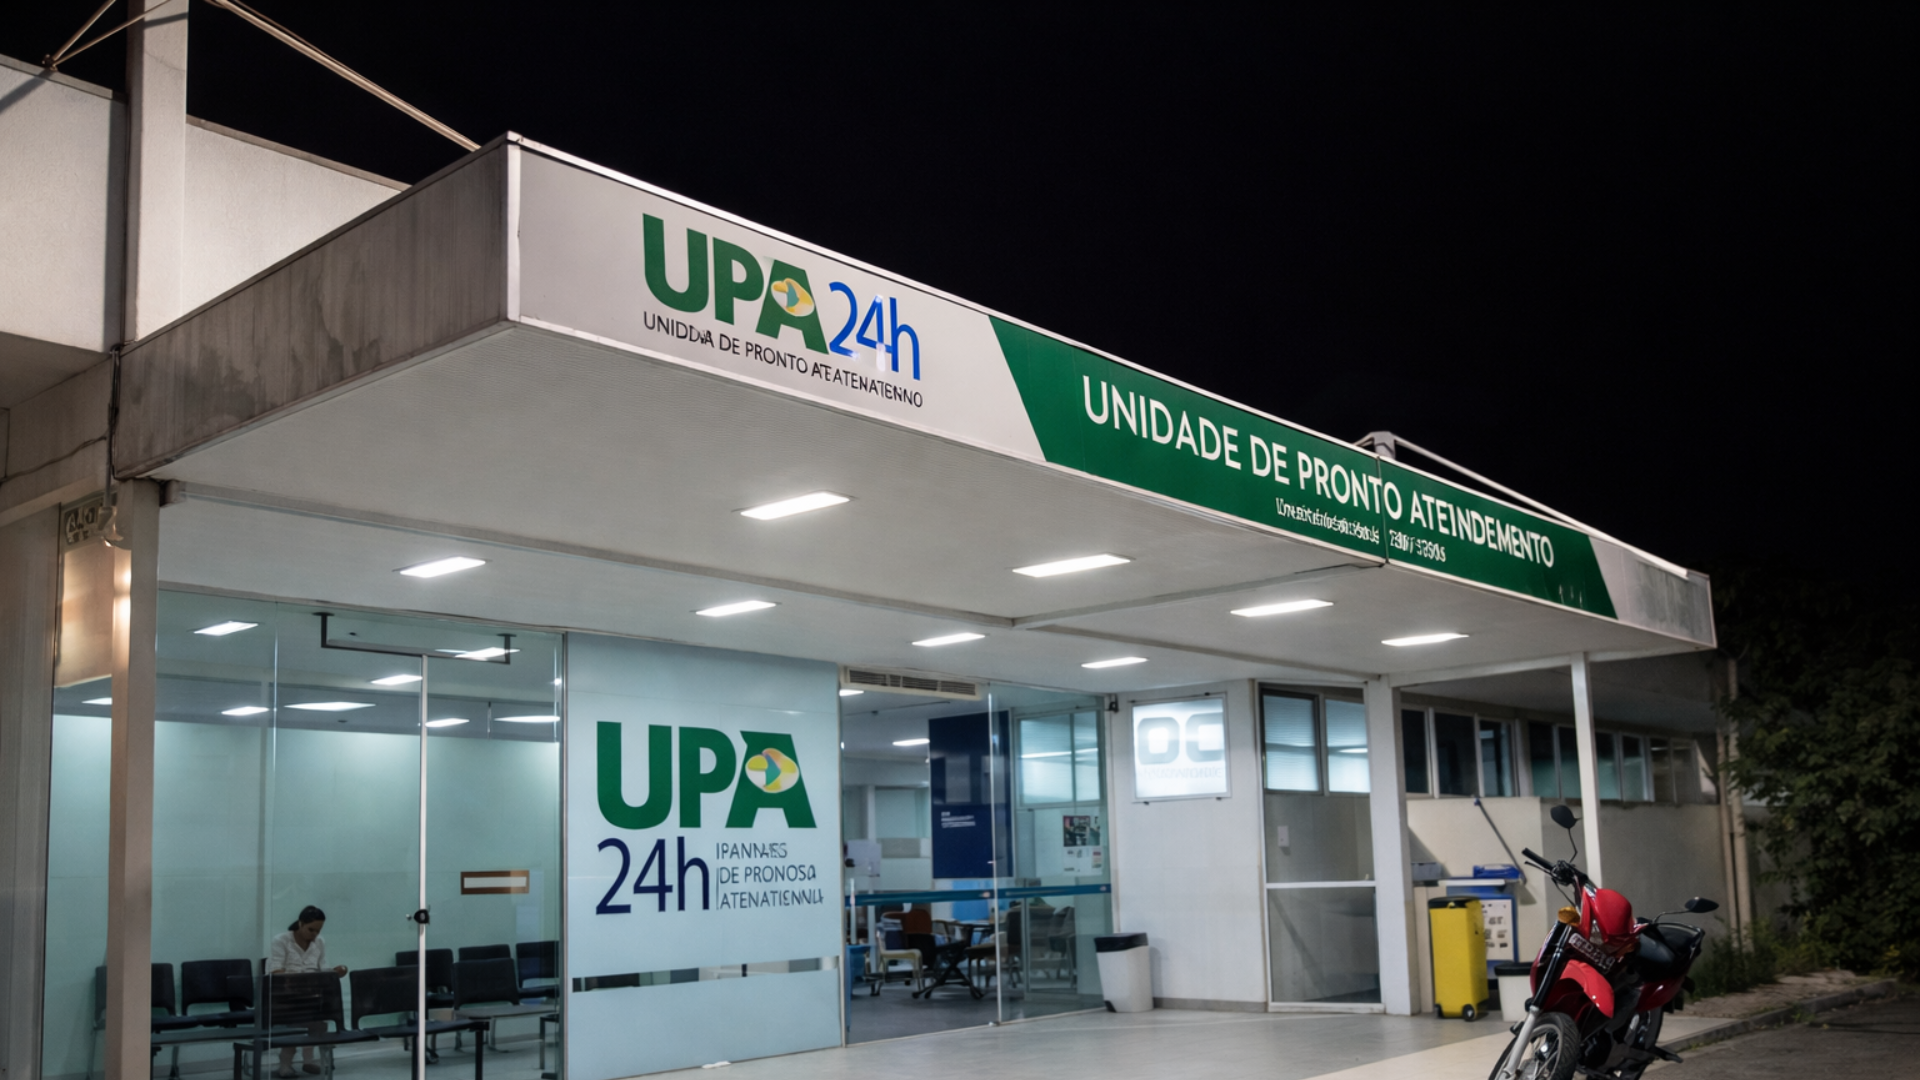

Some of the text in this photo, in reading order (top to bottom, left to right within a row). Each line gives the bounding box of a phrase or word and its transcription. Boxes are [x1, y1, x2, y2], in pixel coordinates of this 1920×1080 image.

[642, 213, 921, 381] UPA 24h
[719, 333, 740, 355] DE
[745, 341, 808, 374] PRONTO
[1082, 375, 1242, 470] UNIDADE
[1249, 434, 1290, 485] DE
[1297, 450, 1403, 520] PRONTO
[596, 720, 817, 830] UPA
[595, 835, 710, 915] 24h
[719, 866, 740, 884] DE
